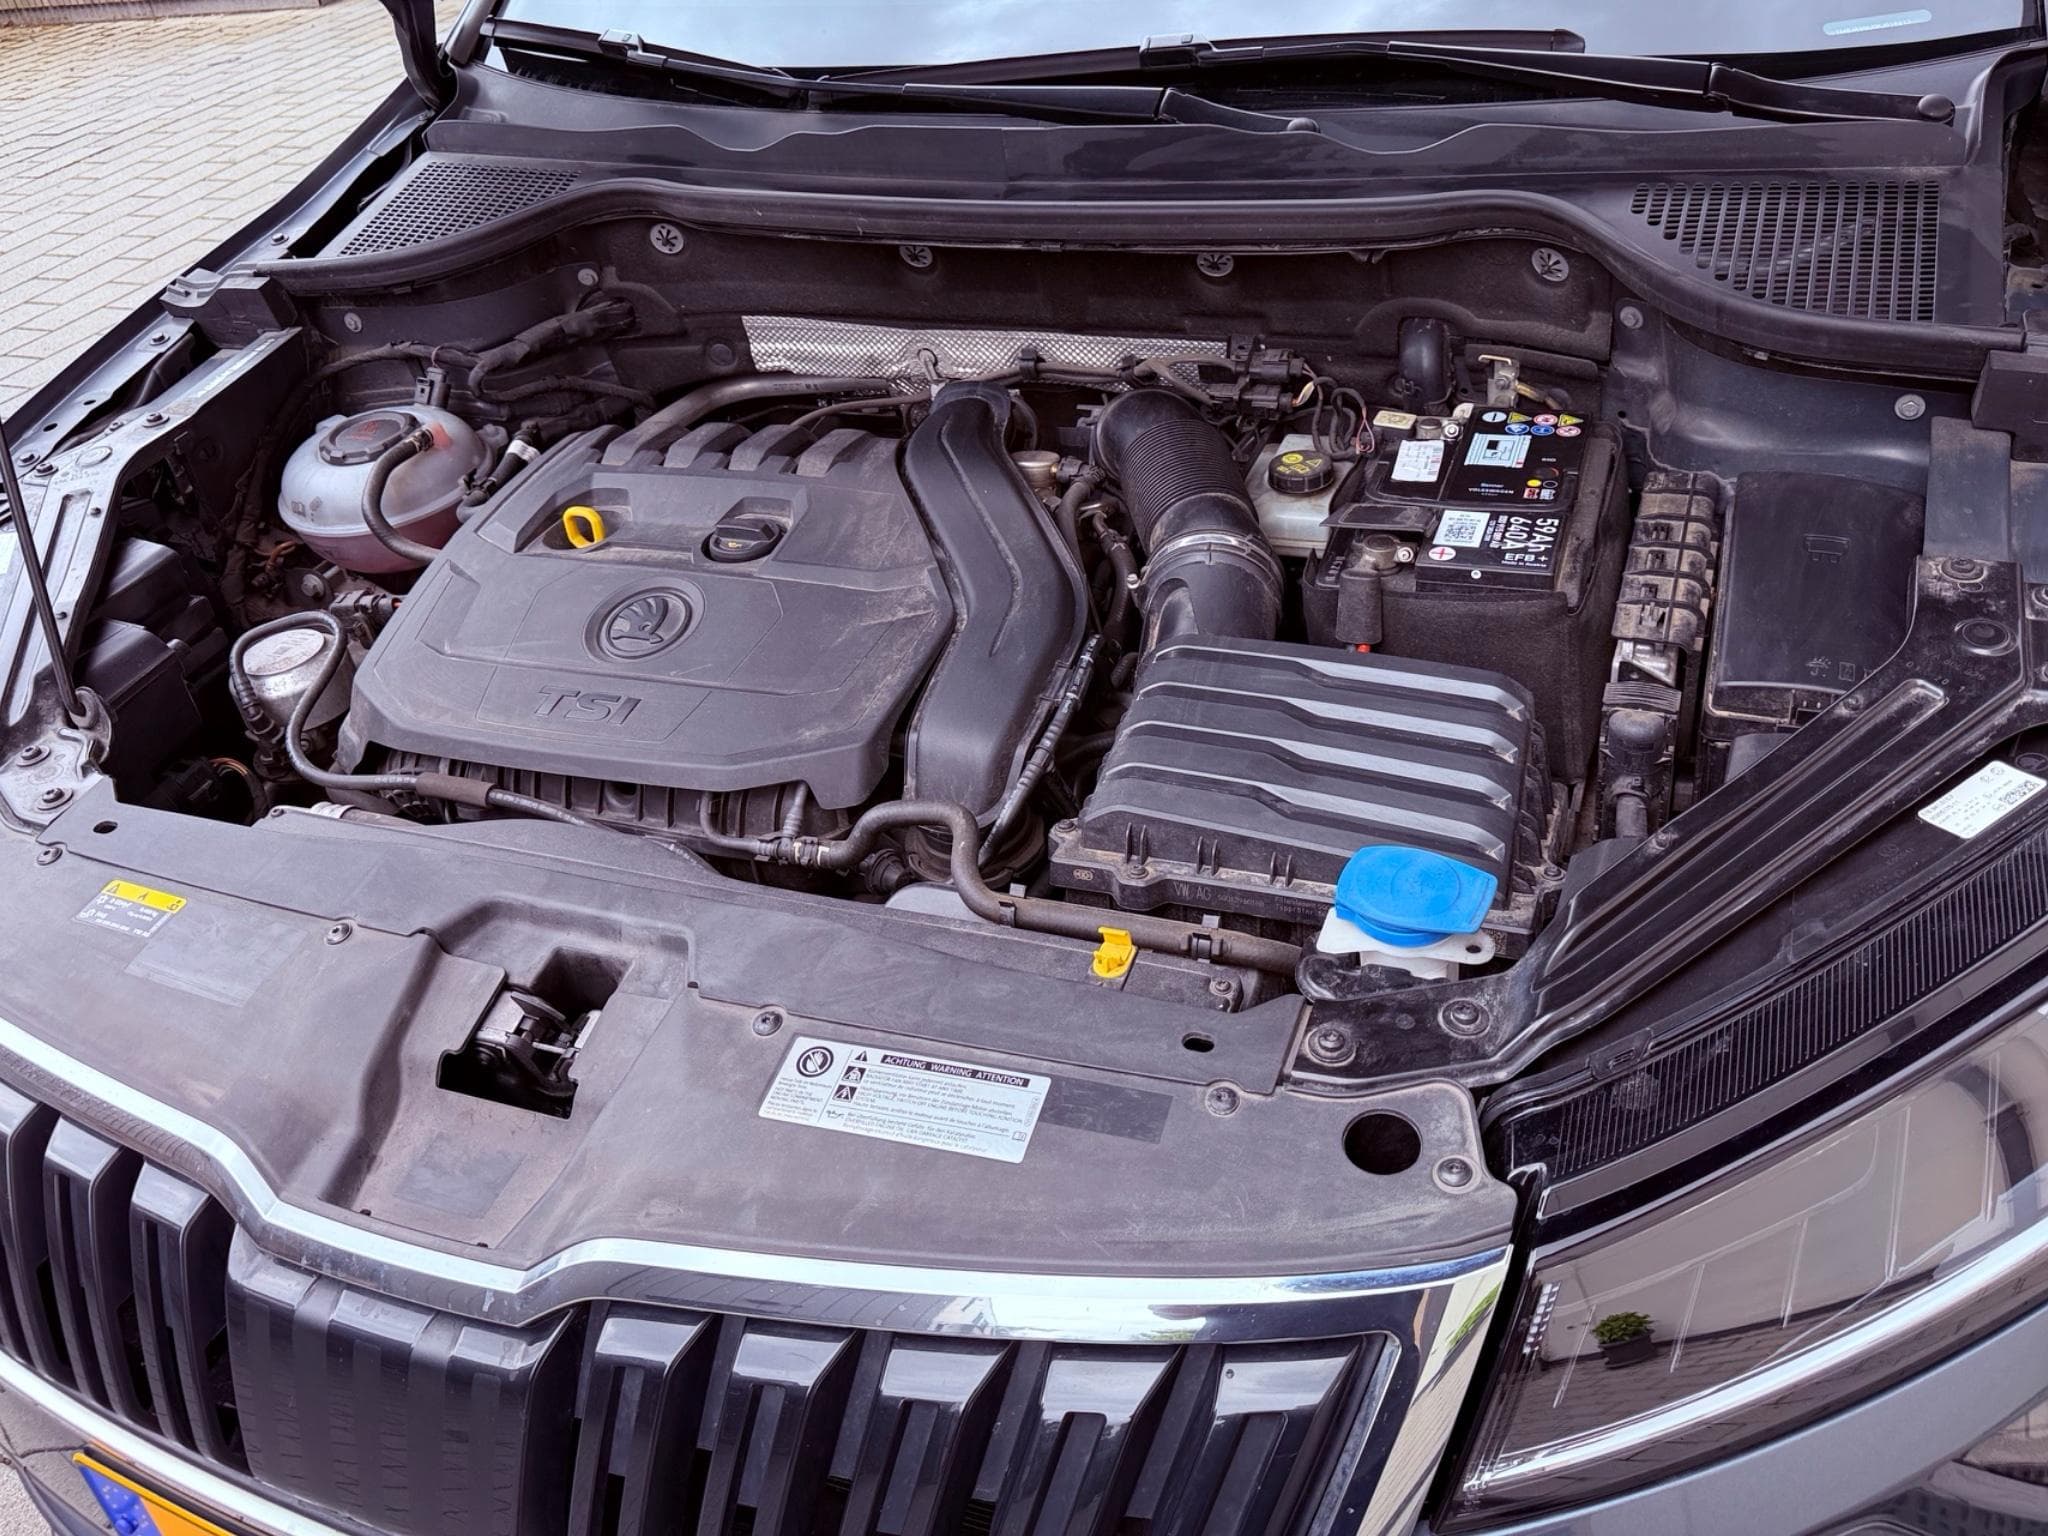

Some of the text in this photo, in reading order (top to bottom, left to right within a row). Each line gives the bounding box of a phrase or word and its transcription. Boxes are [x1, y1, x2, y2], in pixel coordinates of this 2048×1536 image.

[1501, 516, 1532, 549] 640A
[1527, 518, 1560, 552] 59Ah
[534, 685, 642, 726] TSI
[885, 1056, 926, 1070] ACHTUNG
[930, 1063, 973, 1078] WARNING
[975, 1071, 1024, 1085] ATTENTION
